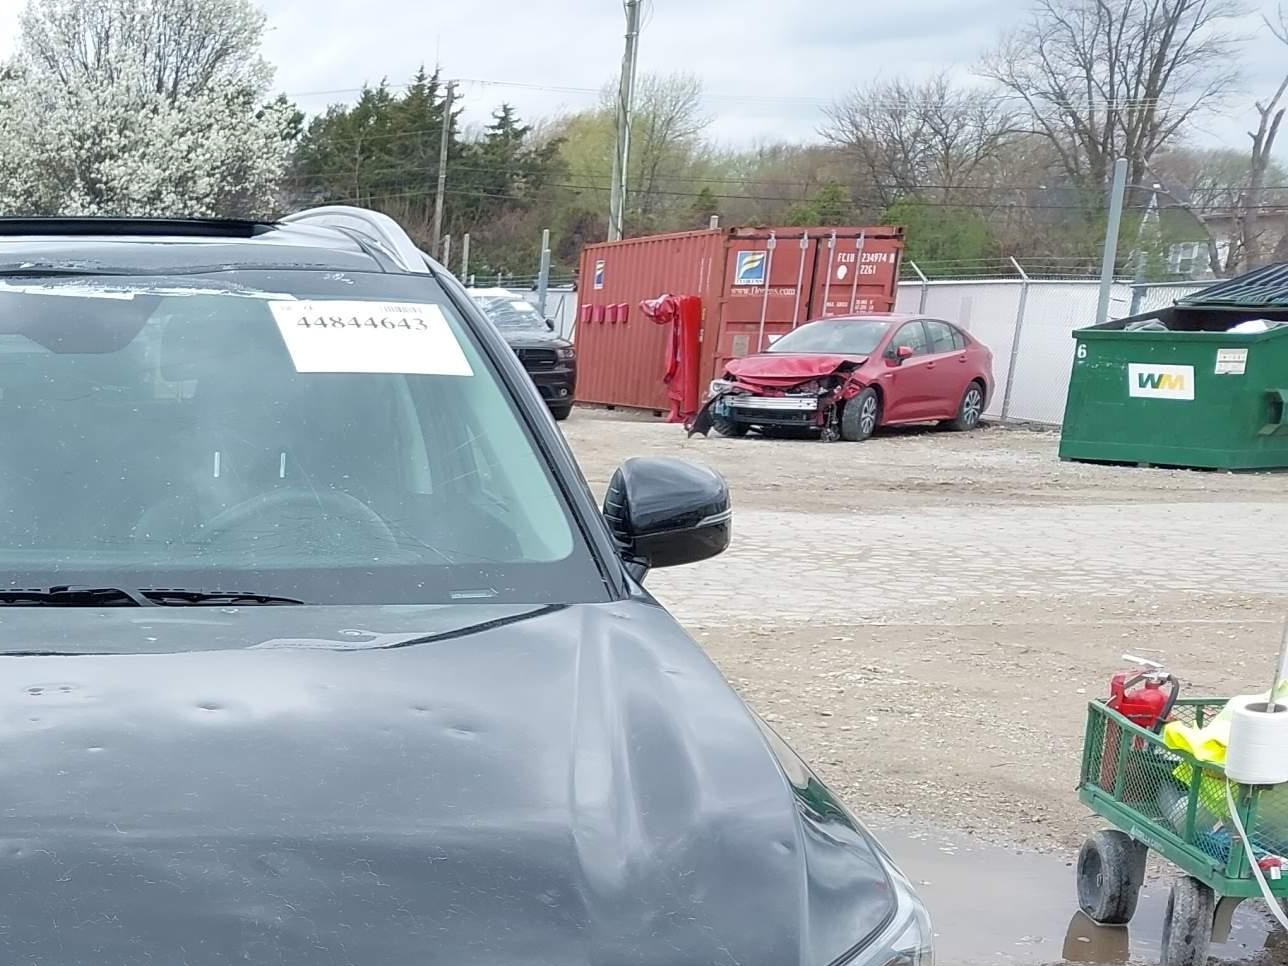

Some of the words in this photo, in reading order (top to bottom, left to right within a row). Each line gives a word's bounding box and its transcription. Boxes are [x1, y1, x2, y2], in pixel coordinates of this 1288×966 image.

[861, 253, 888, 263] 234974
[296, 316, 429, 331] 44844643
[1077, 343, 1088, 359] 6
[1137, 372, 1185, 390] WM
